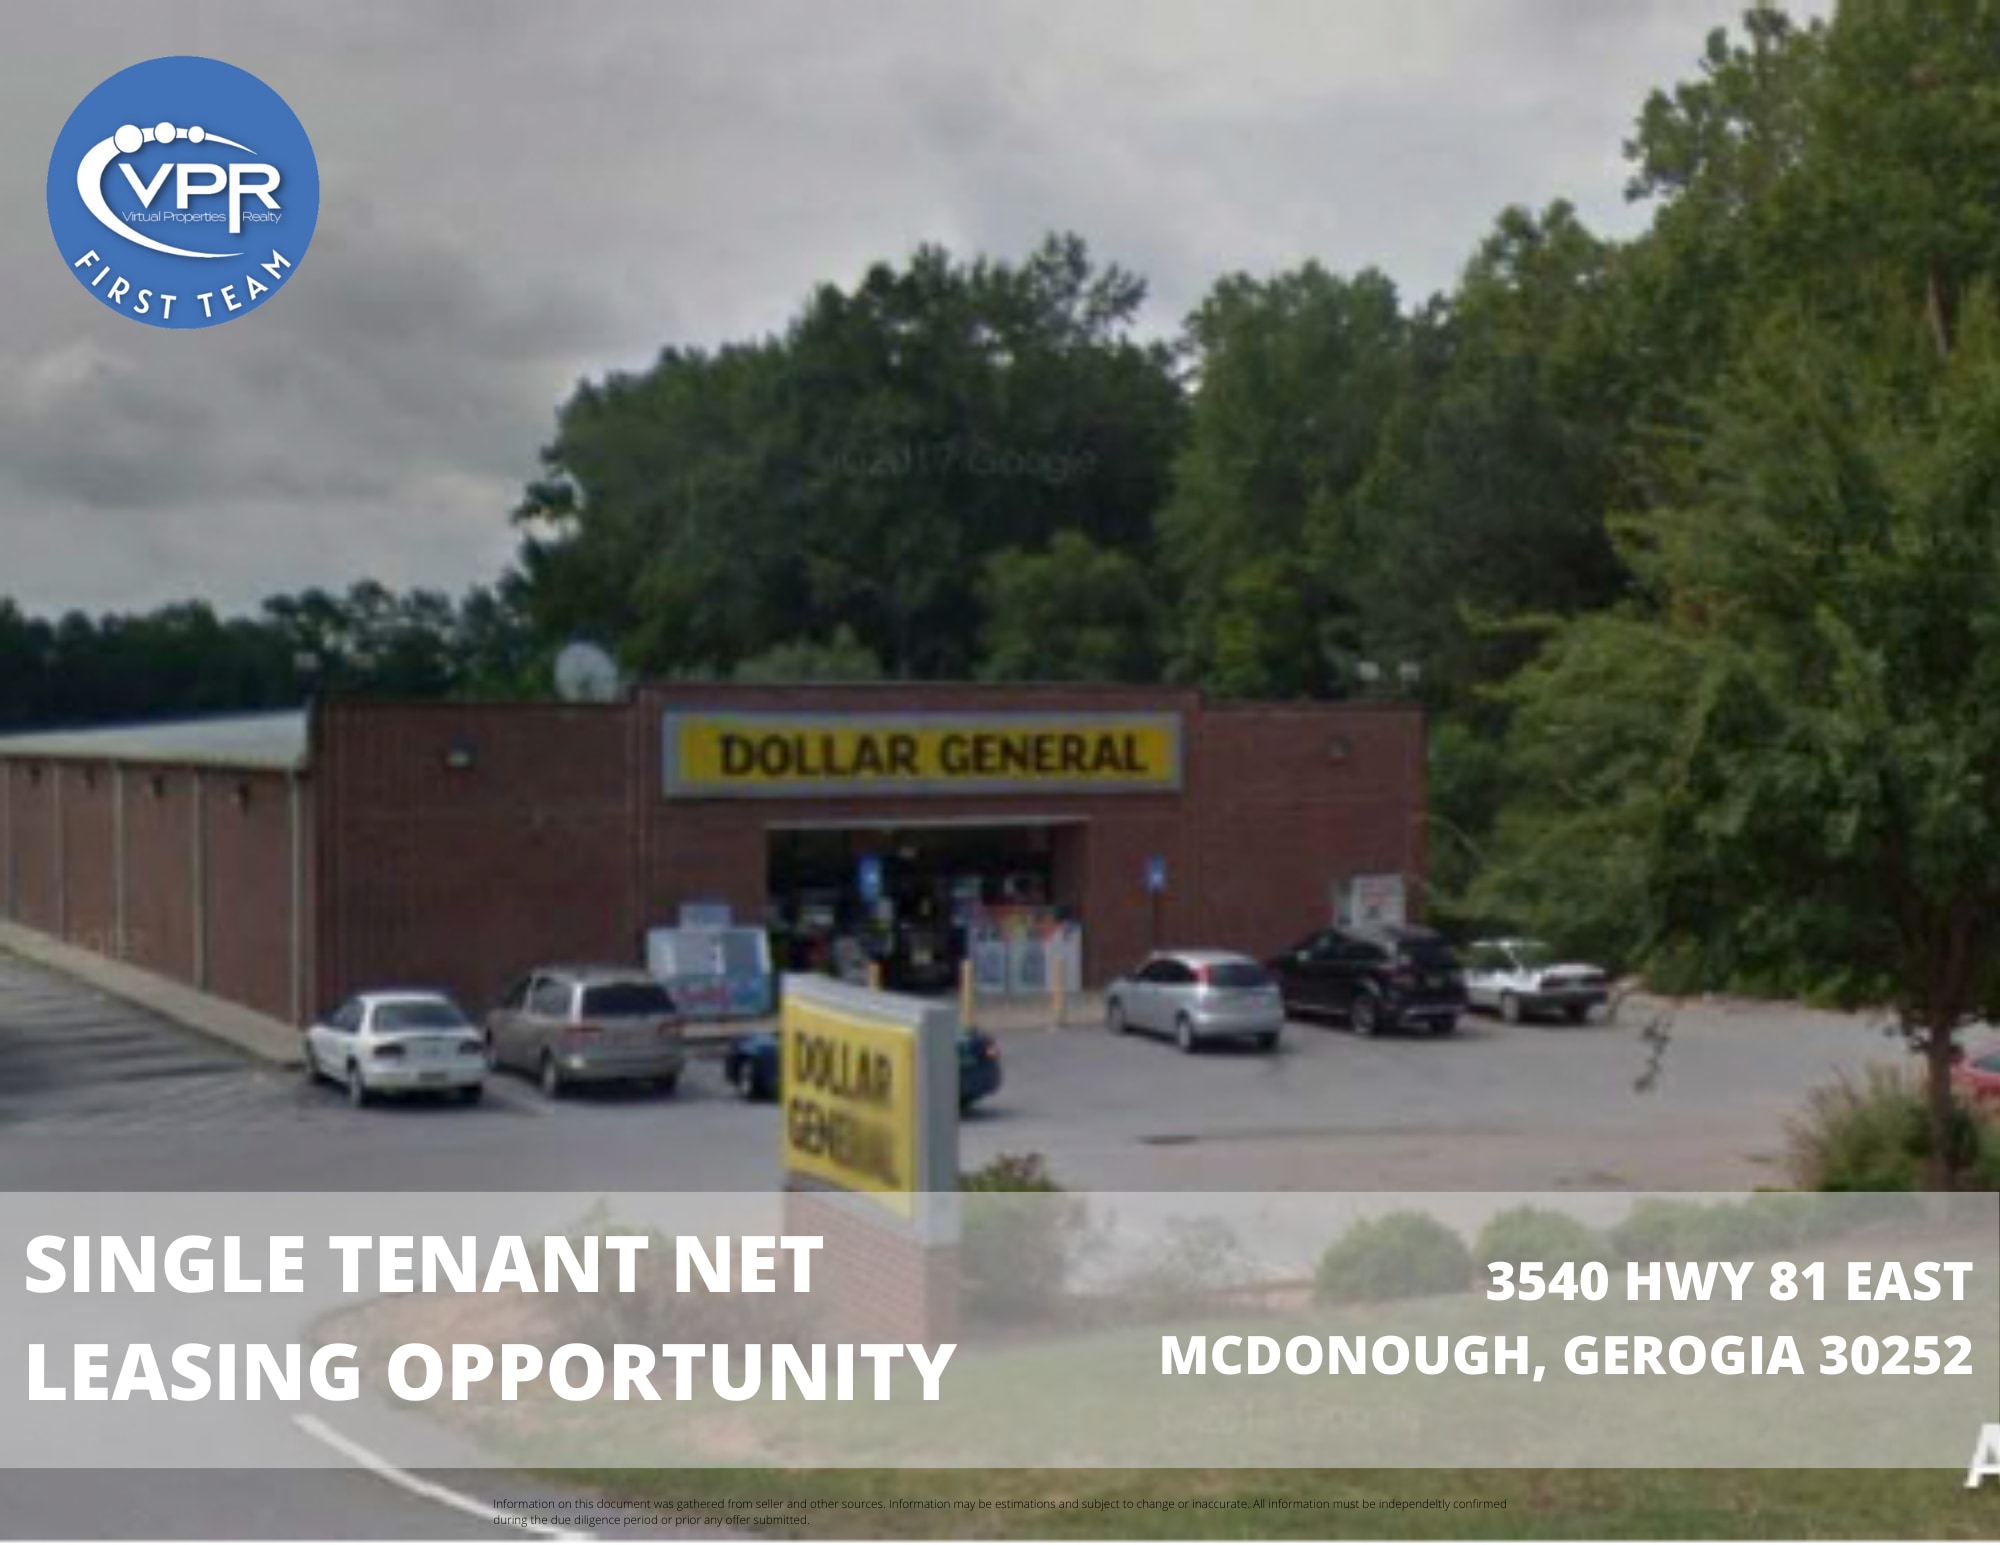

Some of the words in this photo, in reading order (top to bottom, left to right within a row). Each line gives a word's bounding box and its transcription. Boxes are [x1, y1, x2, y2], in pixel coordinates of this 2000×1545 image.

[719, 733, 918, 776] DOLLAR
[939, 733, 1148, 774] GENERAL
[795, 1032, 893, 1106] DOLLAR
